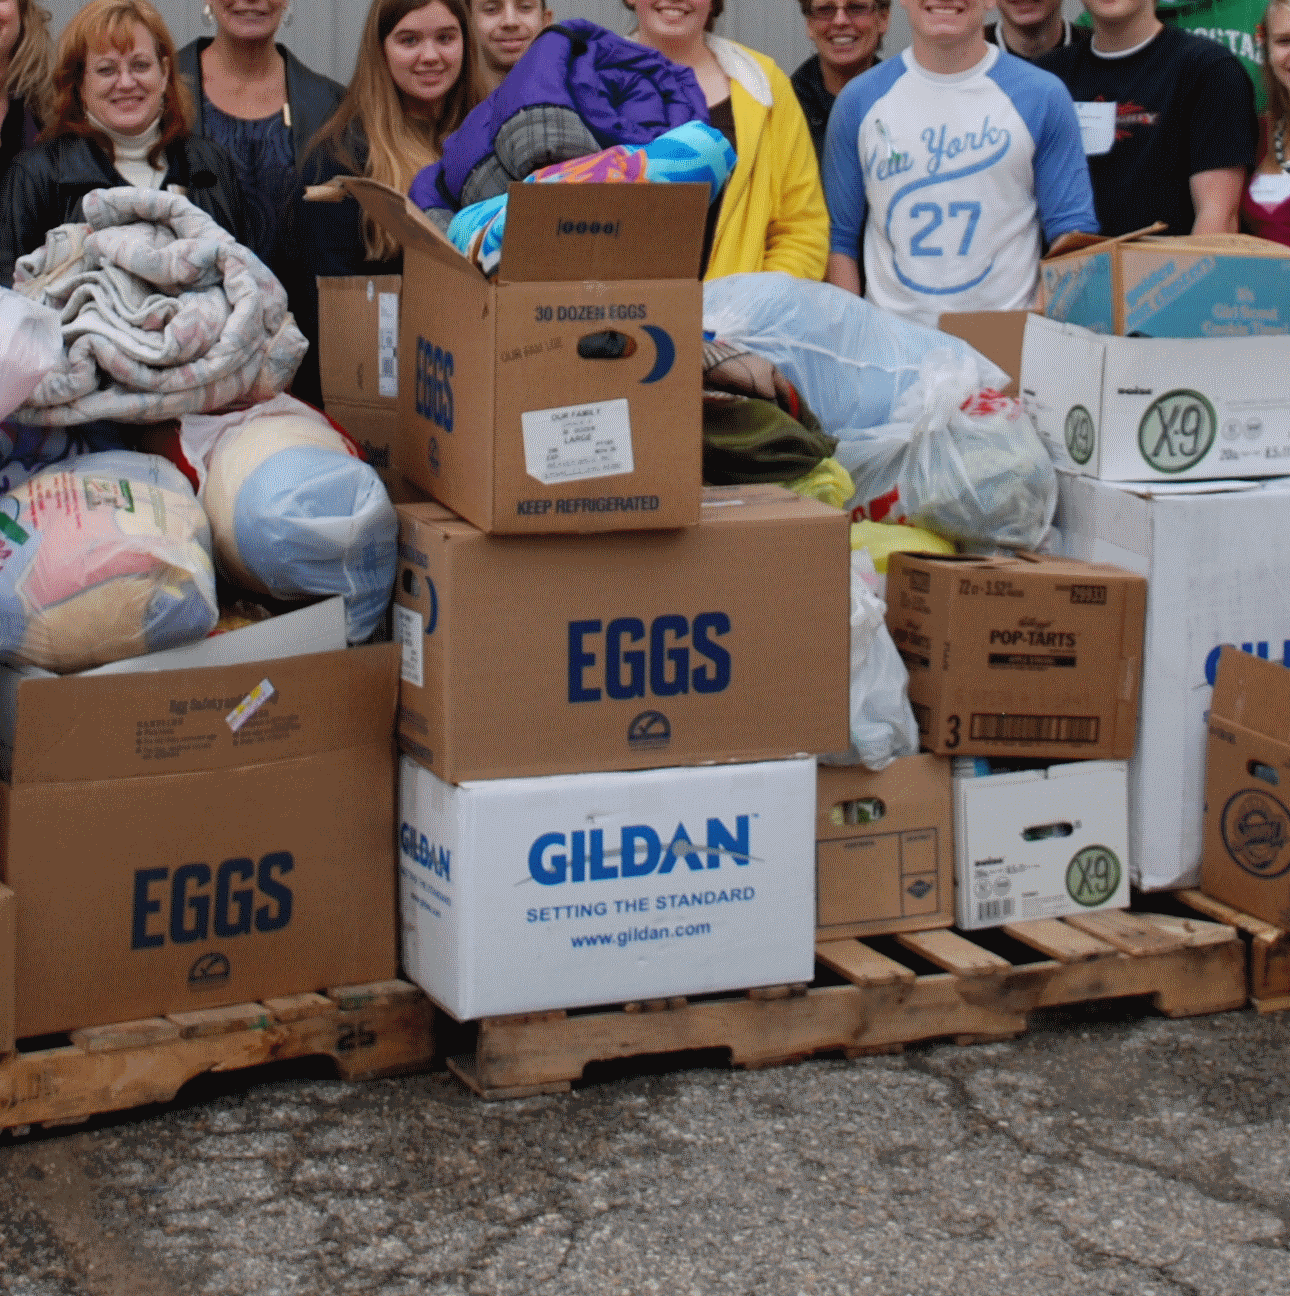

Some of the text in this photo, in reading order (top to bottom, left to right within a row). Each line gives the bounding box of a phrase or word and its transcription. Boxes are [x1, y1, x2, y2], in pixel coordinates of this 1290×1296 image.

[920, 115, 999, 177] York
[909, 201, 982, 257] 27
[535, 304, 647, 322] 30 DOZEN EGGS
[416, 335, 454, 433] EGGS
[517, 495, 660, 516] KEEP REFRIGERATED
[568, 611, 731, 704] EGGS
[989, 629, 1077, 648] POP-TARTS
[945, 714, 961, 749] 3
[400, 821, 452, 884] GILDAN
[527, 814, 751, 887] GILDAN
[131, 850, 294, 951] EGGS
[526, 886, 756, 924] SETTING THE STANDARD
[571, 920, 712, 949] www.gildan.com
